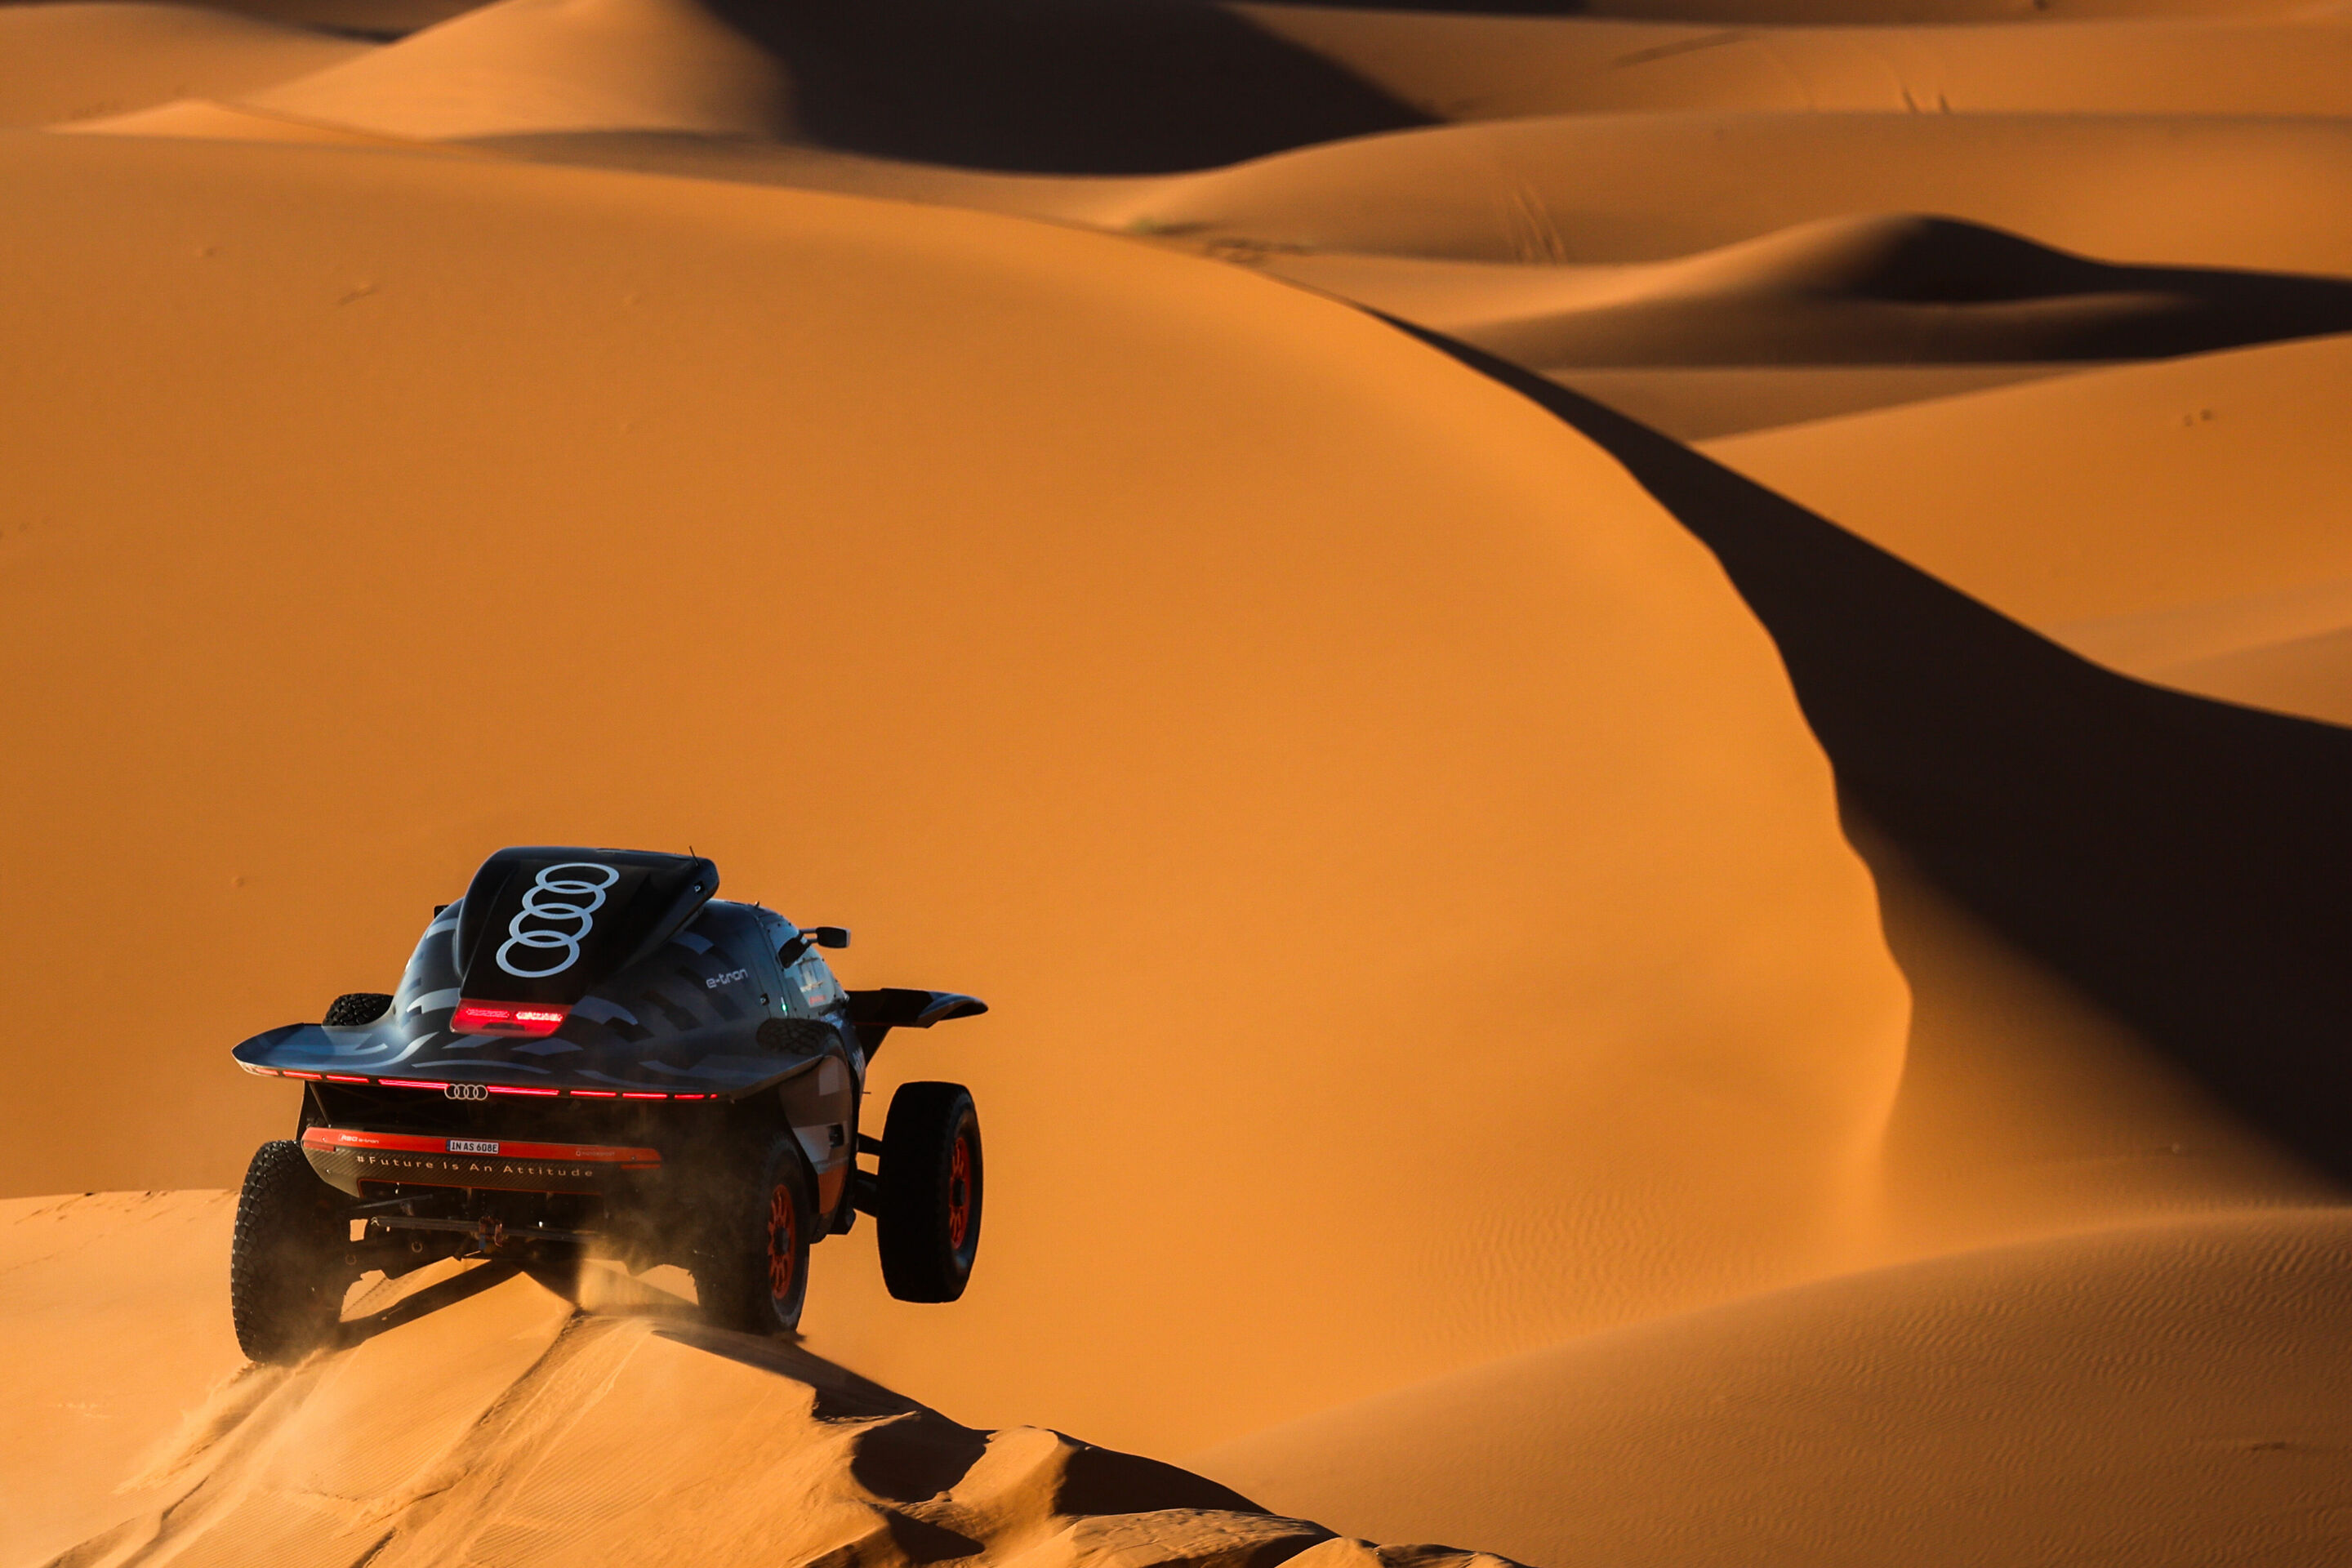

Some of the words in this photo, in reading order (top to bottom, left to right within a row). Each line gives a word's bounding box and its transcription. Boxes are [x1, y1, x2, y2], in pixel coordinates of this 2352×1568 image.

[706, 969, 748, 988] e-tron
[452, 1142, 461, 1151] IN
[463, 1143, 474, 1152] AS
[476, 1143, 497, 1152] 608E
[357, 1155, 434, 1169] #Future
[443, 1161, 459, 1170] Is
[470, 1163, 492, 1172] An
[503, 1165, 593, 1177] Attitude
